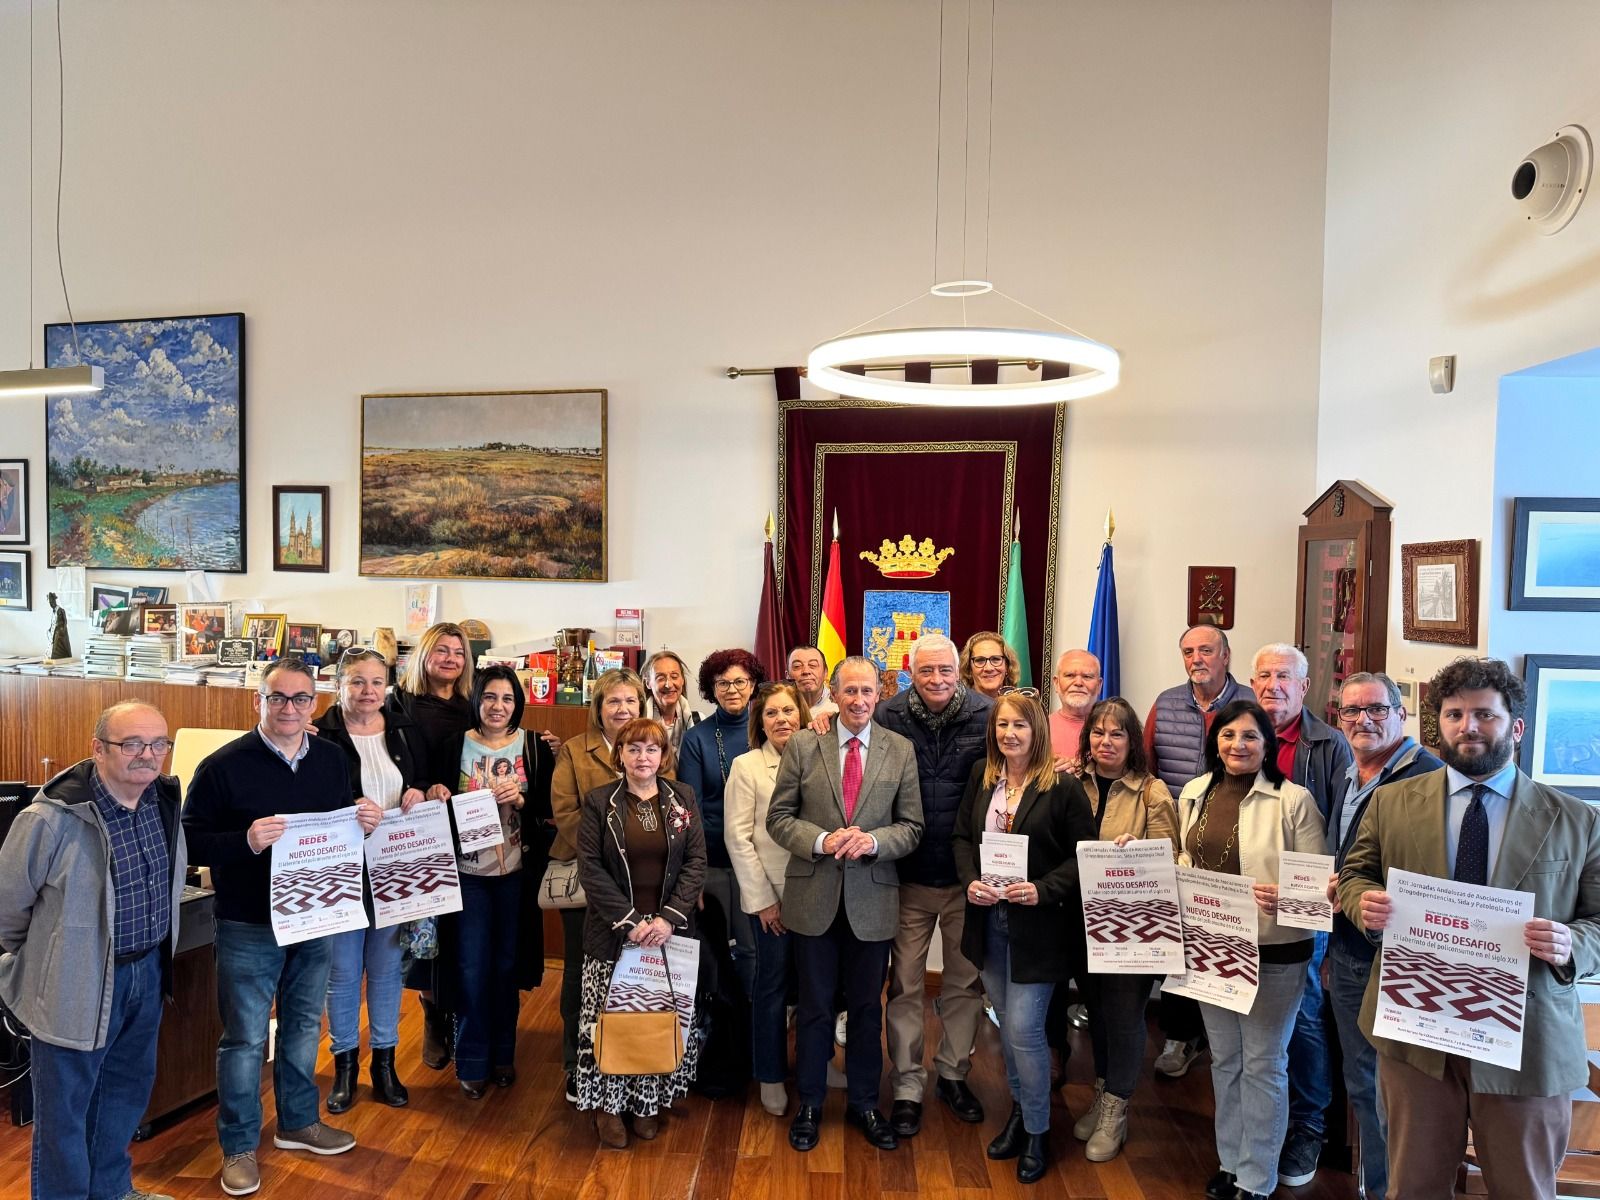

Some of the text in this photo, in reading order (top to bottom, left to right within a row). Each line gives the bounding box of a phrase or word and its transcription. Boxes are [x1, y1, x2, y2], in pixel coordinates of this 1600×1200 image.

[298, 836, 328, 846] REDES
[388, 831, 416, 841] REDES
[289, 844, 347, 860] NUEVOS DESAFIOS
[382, 837, 436, 854] NUEVOS DESAFIOS
[1194, 896, 1220, 907] REDES
[1186, 906, 1241, 924] NUEVOS DESAFIOS
[1425, 913, 1469, 930] REDES
[1410, 926, 1501, 952] NUEVOS DESAFIOS
[1400, 935, 1425, 946] laberinto
[1492, 954, 1506, 962] siglo
[640, 956, 665, 966] REDES
[629, 967, 652, 976] NUEVOS
